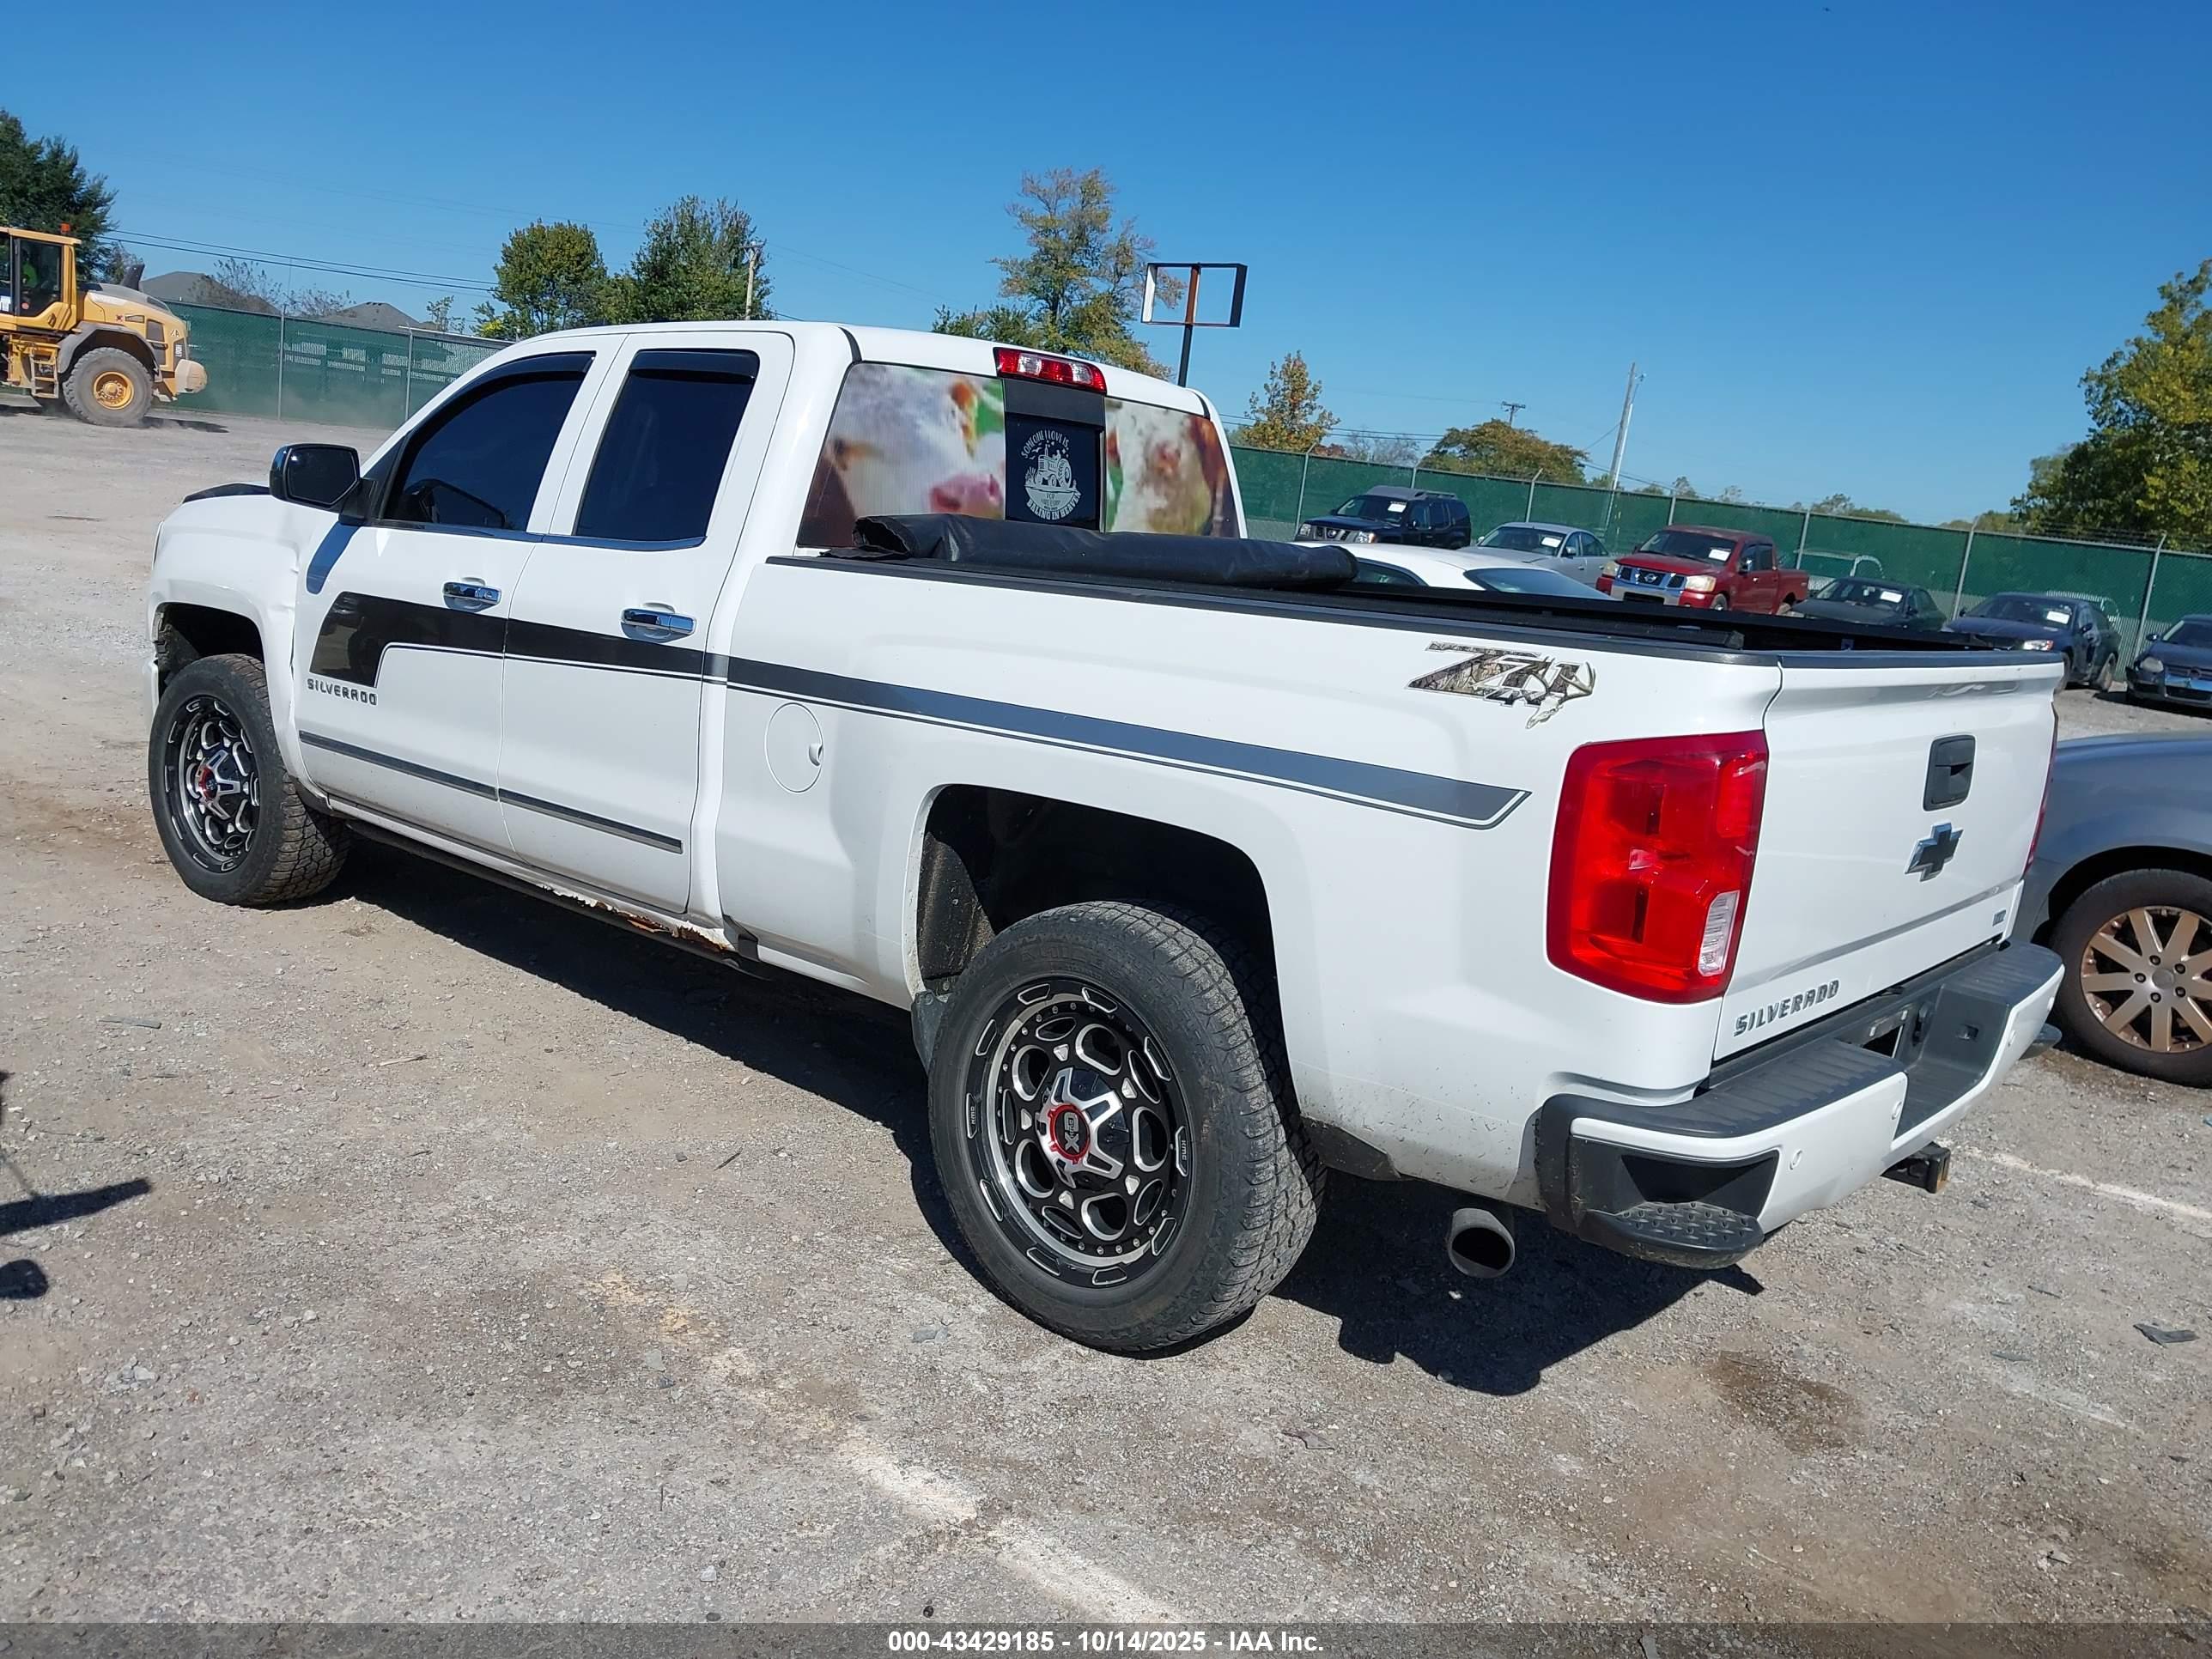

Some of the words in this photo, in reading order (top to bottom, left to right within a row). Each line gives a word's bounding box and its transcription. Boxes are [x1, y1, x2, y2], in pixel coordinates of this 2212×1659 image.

[1026, 498, 1051, 520] BALING
[1051, 511, 1060, 520] IN
[1060, 489, 1082, 519] HEAVEN
[307, 678, 378, 706] SILVERADO
[1733, 979, 1839, 1037] SILVERADO
